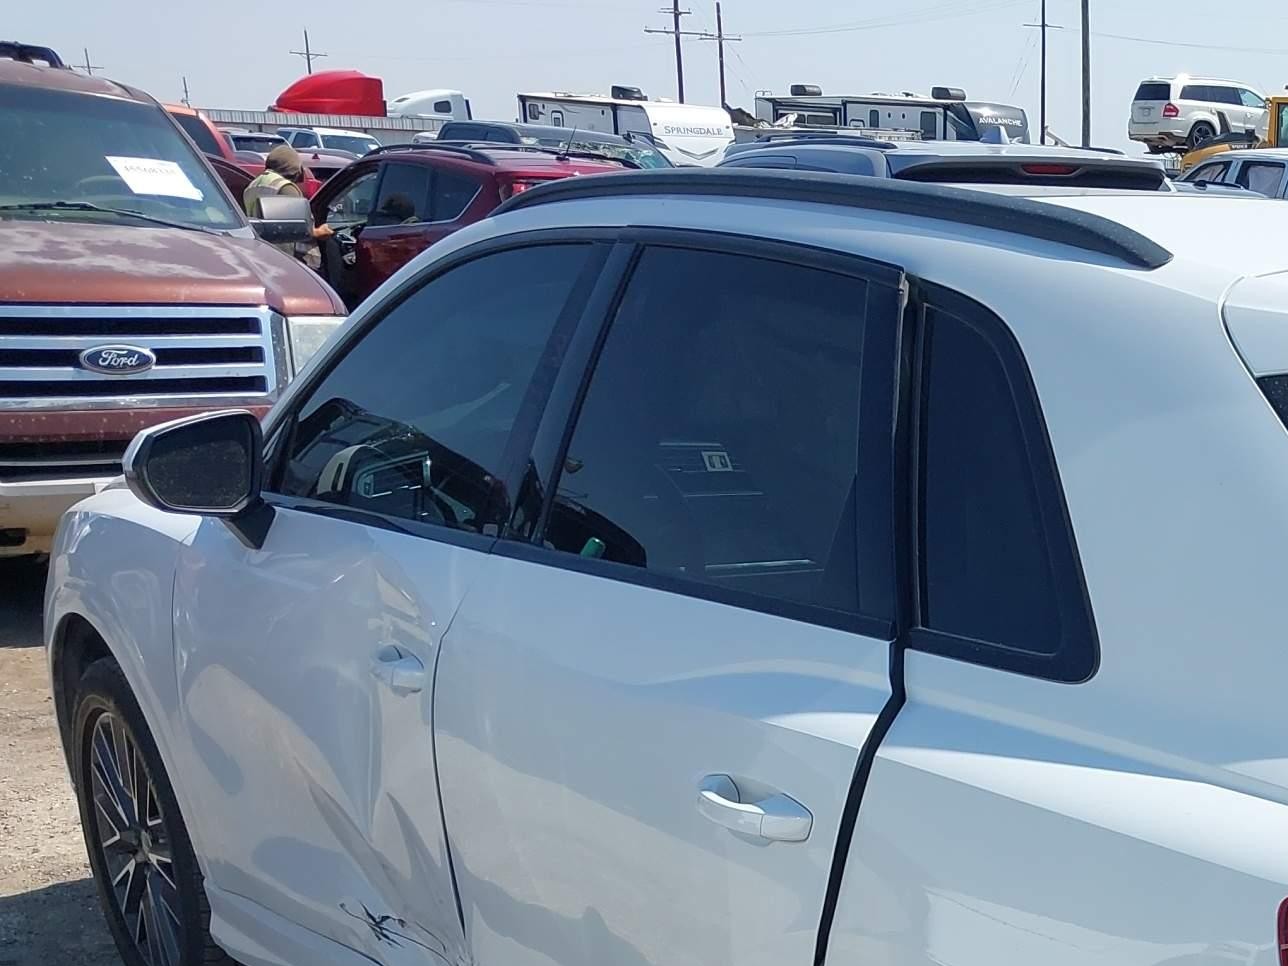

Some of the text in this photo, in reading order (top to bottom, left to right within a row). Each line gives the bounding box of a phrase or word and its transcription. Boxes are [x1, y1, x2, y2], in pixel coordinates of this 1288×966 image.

[979, 117, 1023, 127] AVALANCHE
[664, 126, 723, 136] SPRINGDALE
[98, 349, 140, 367] Ford
